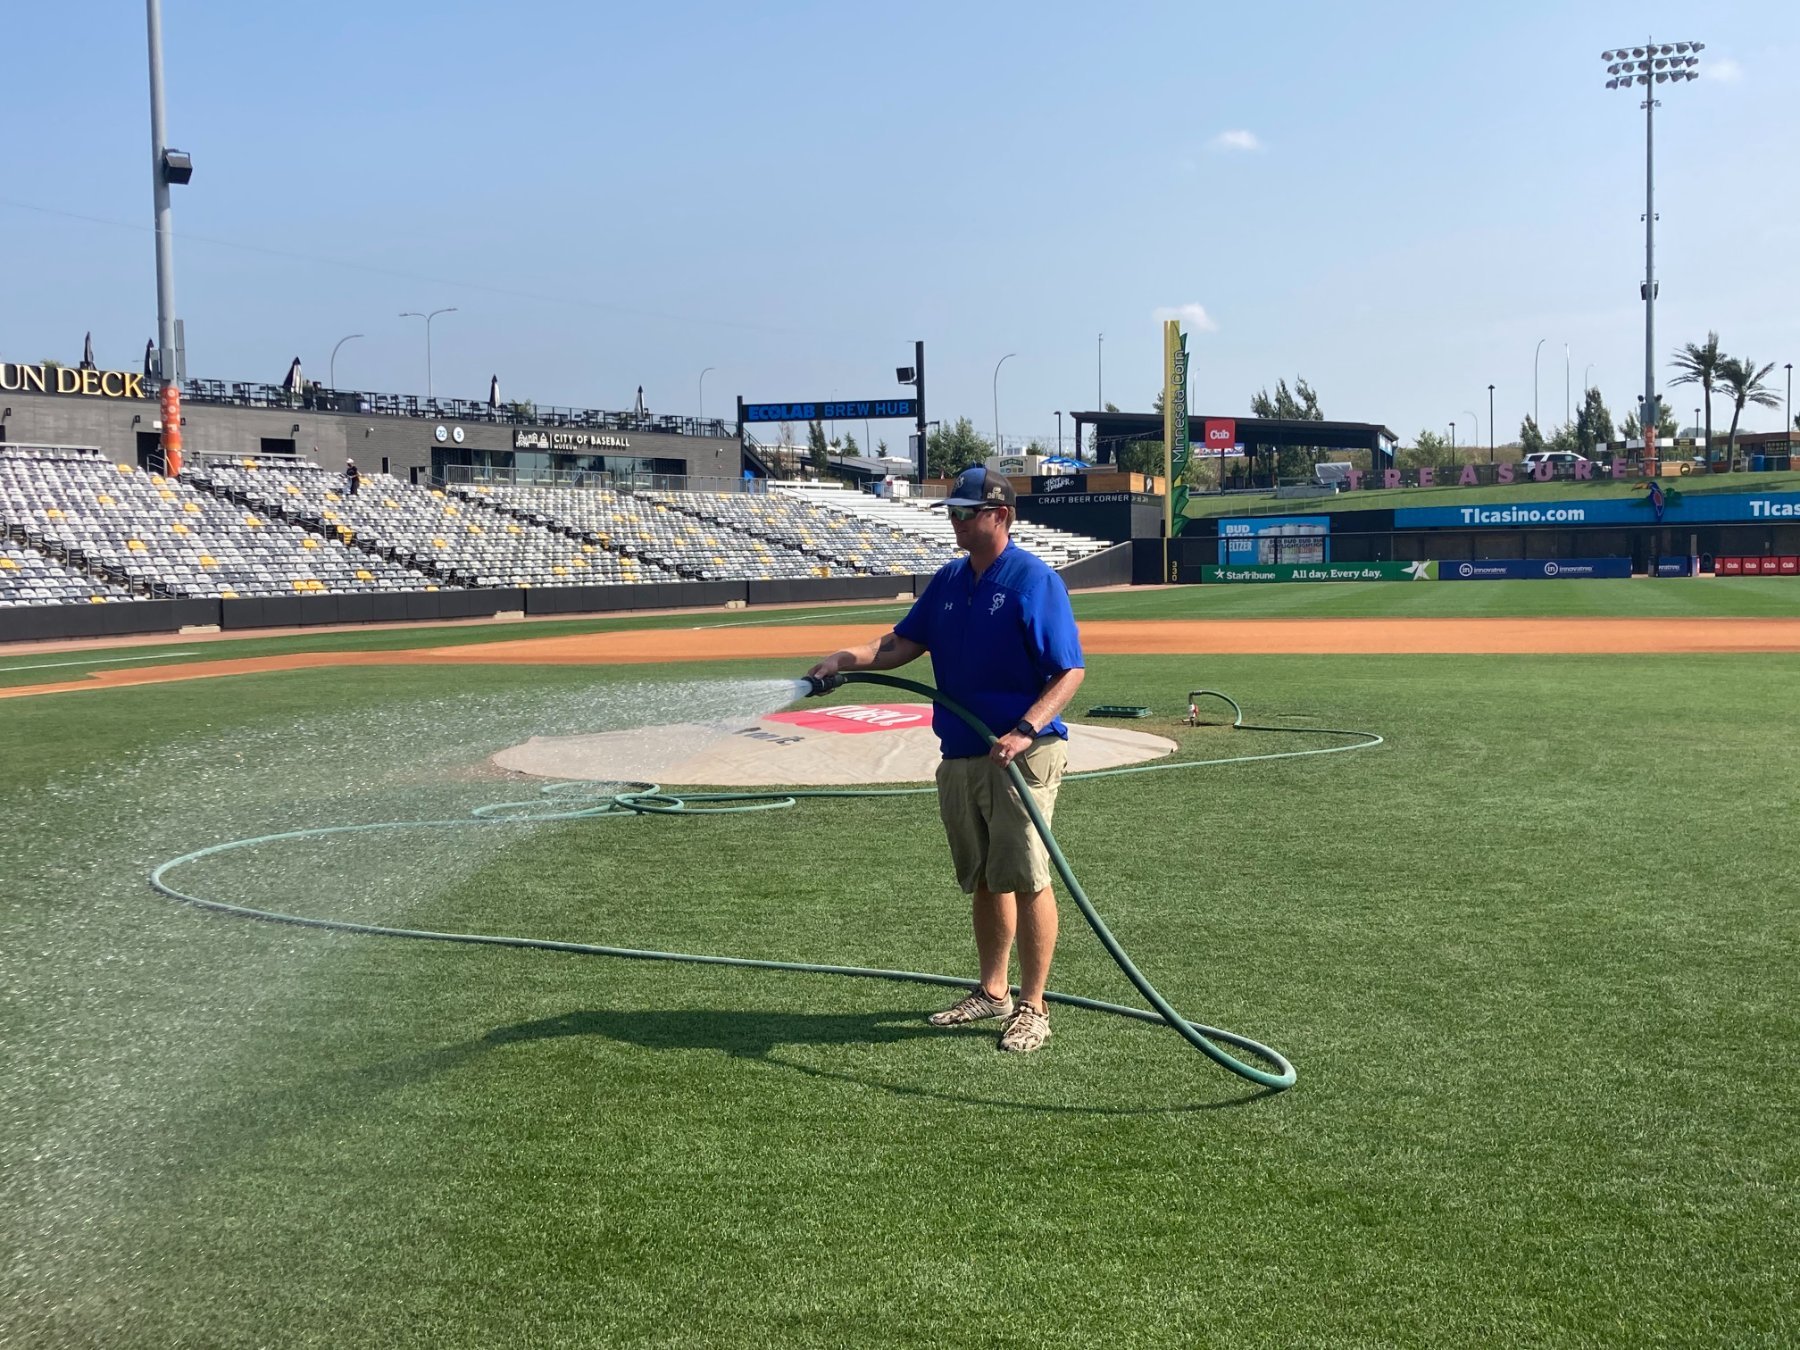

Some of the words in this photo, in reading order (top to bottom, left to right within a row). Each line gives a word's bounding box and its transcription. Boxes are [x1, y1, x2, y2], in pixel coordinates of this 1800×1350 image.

[1171, 349, 1185, 386] Corn
[57, 367, 145, 398] DECK
[748, 404, 816, 420] ECOLAB
[824, 402, 870, 417] BREW
[875, 401, 909, 416] HUB
[1172, 389, 1185, 463] Minnesota
[553, 433, 573, 443] CITY
[576, 434, 588, 444] OF
[591, 435, 630, 447] BASEBALL
[1210, 429, 1230, 440] Cub
[1038, 496, 1065, 505] CRAFT
[1068, 495, 1091, 504] BEER
[1094, 494, 1129, 503] CORNER
[1226, 525, 1250, 533] BUD
[1226, 571, 1276, 580] StarTribune
[1292, 570, 1307, 579] All
[1309, 569, 1329, 580] day.
[1331, 569, 1360, 580] Every
[1362, 568, 1382, 579] day.
